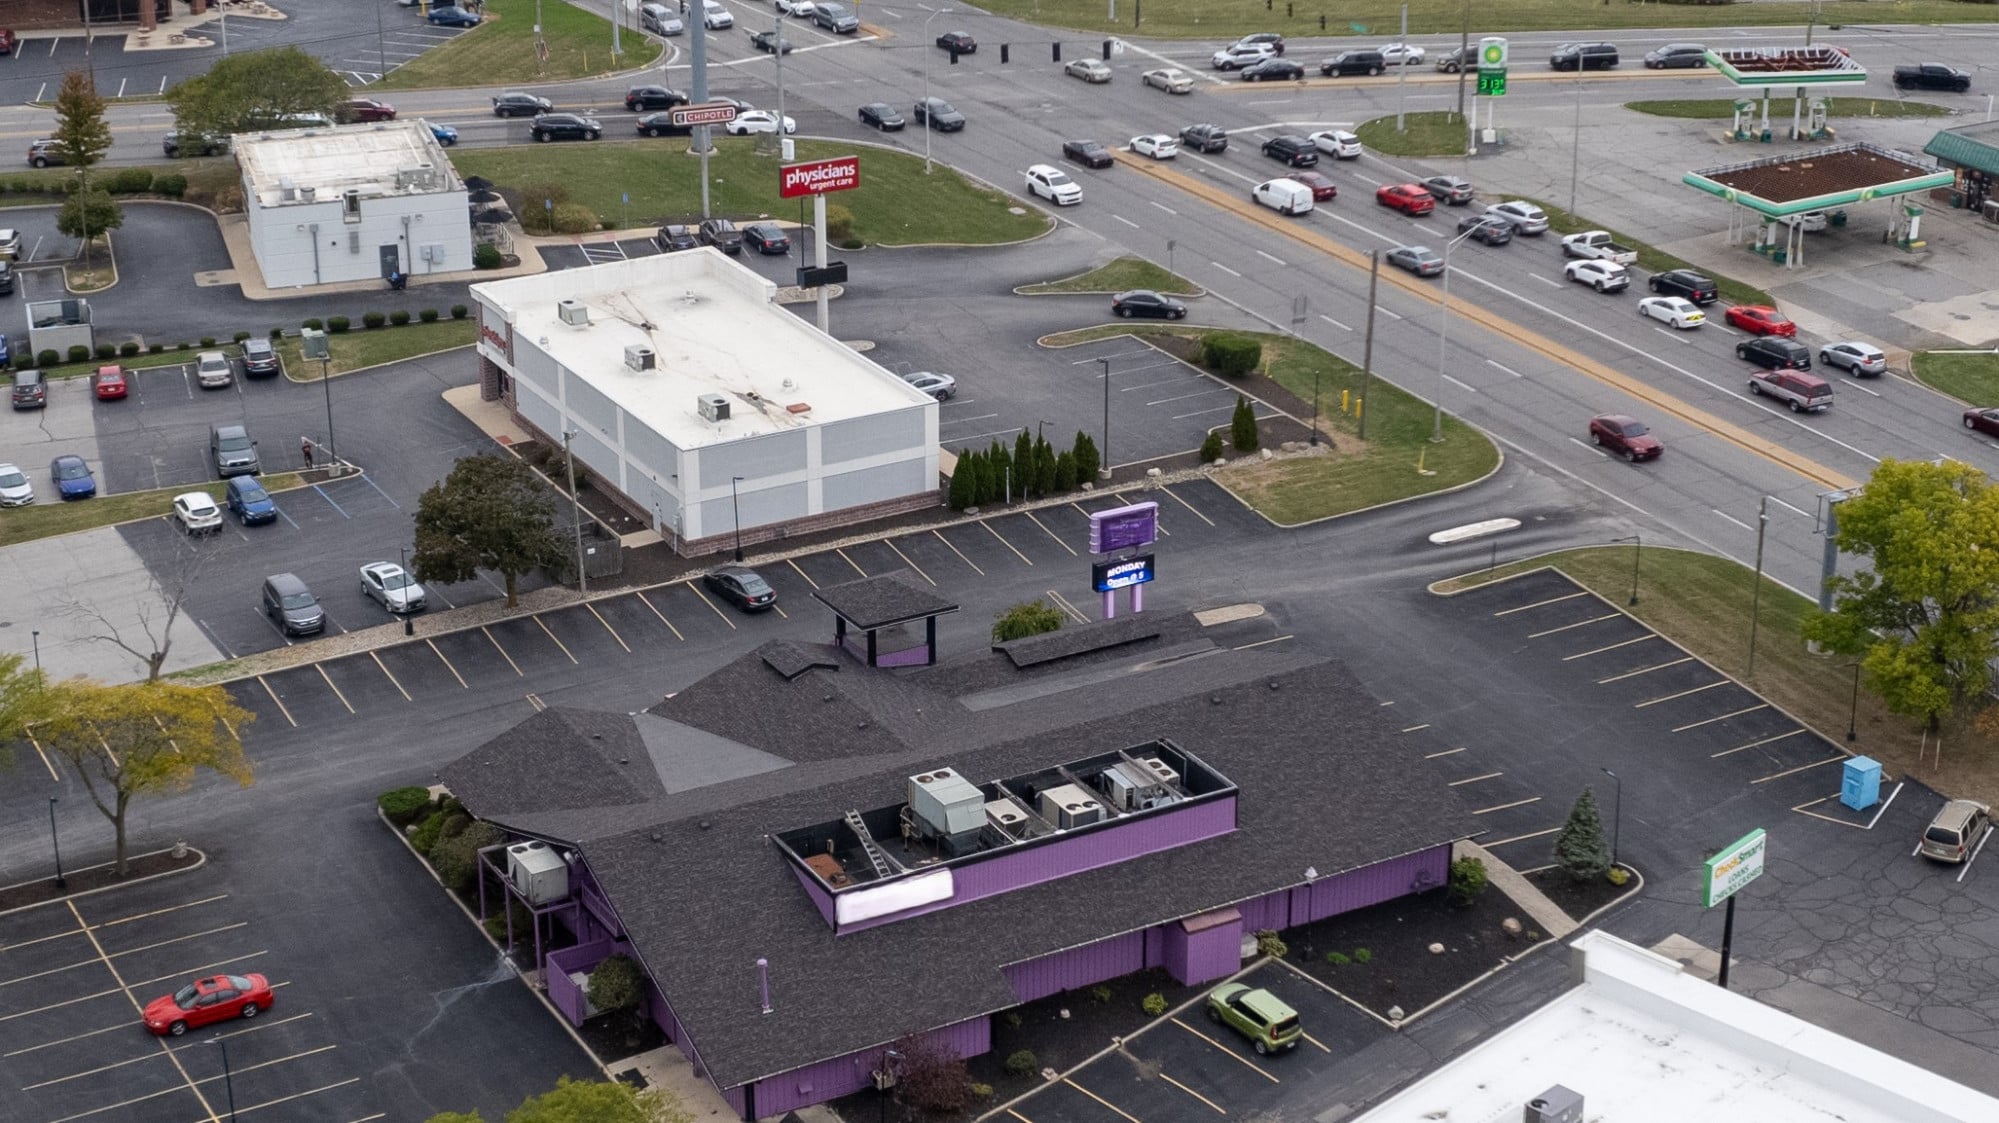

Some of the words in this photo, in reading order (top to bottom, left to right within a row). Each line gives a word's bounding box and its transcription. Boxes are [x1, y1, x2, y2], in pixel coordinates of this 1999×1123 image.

[687, 110, 732, 121] CHIPOTLE
[786, 164, 855, 188] physicians
[810, 179, 835, 190] urgent
[836, 178, 853, 186] care
[1107, 561, 1145, 578] MONDAY
